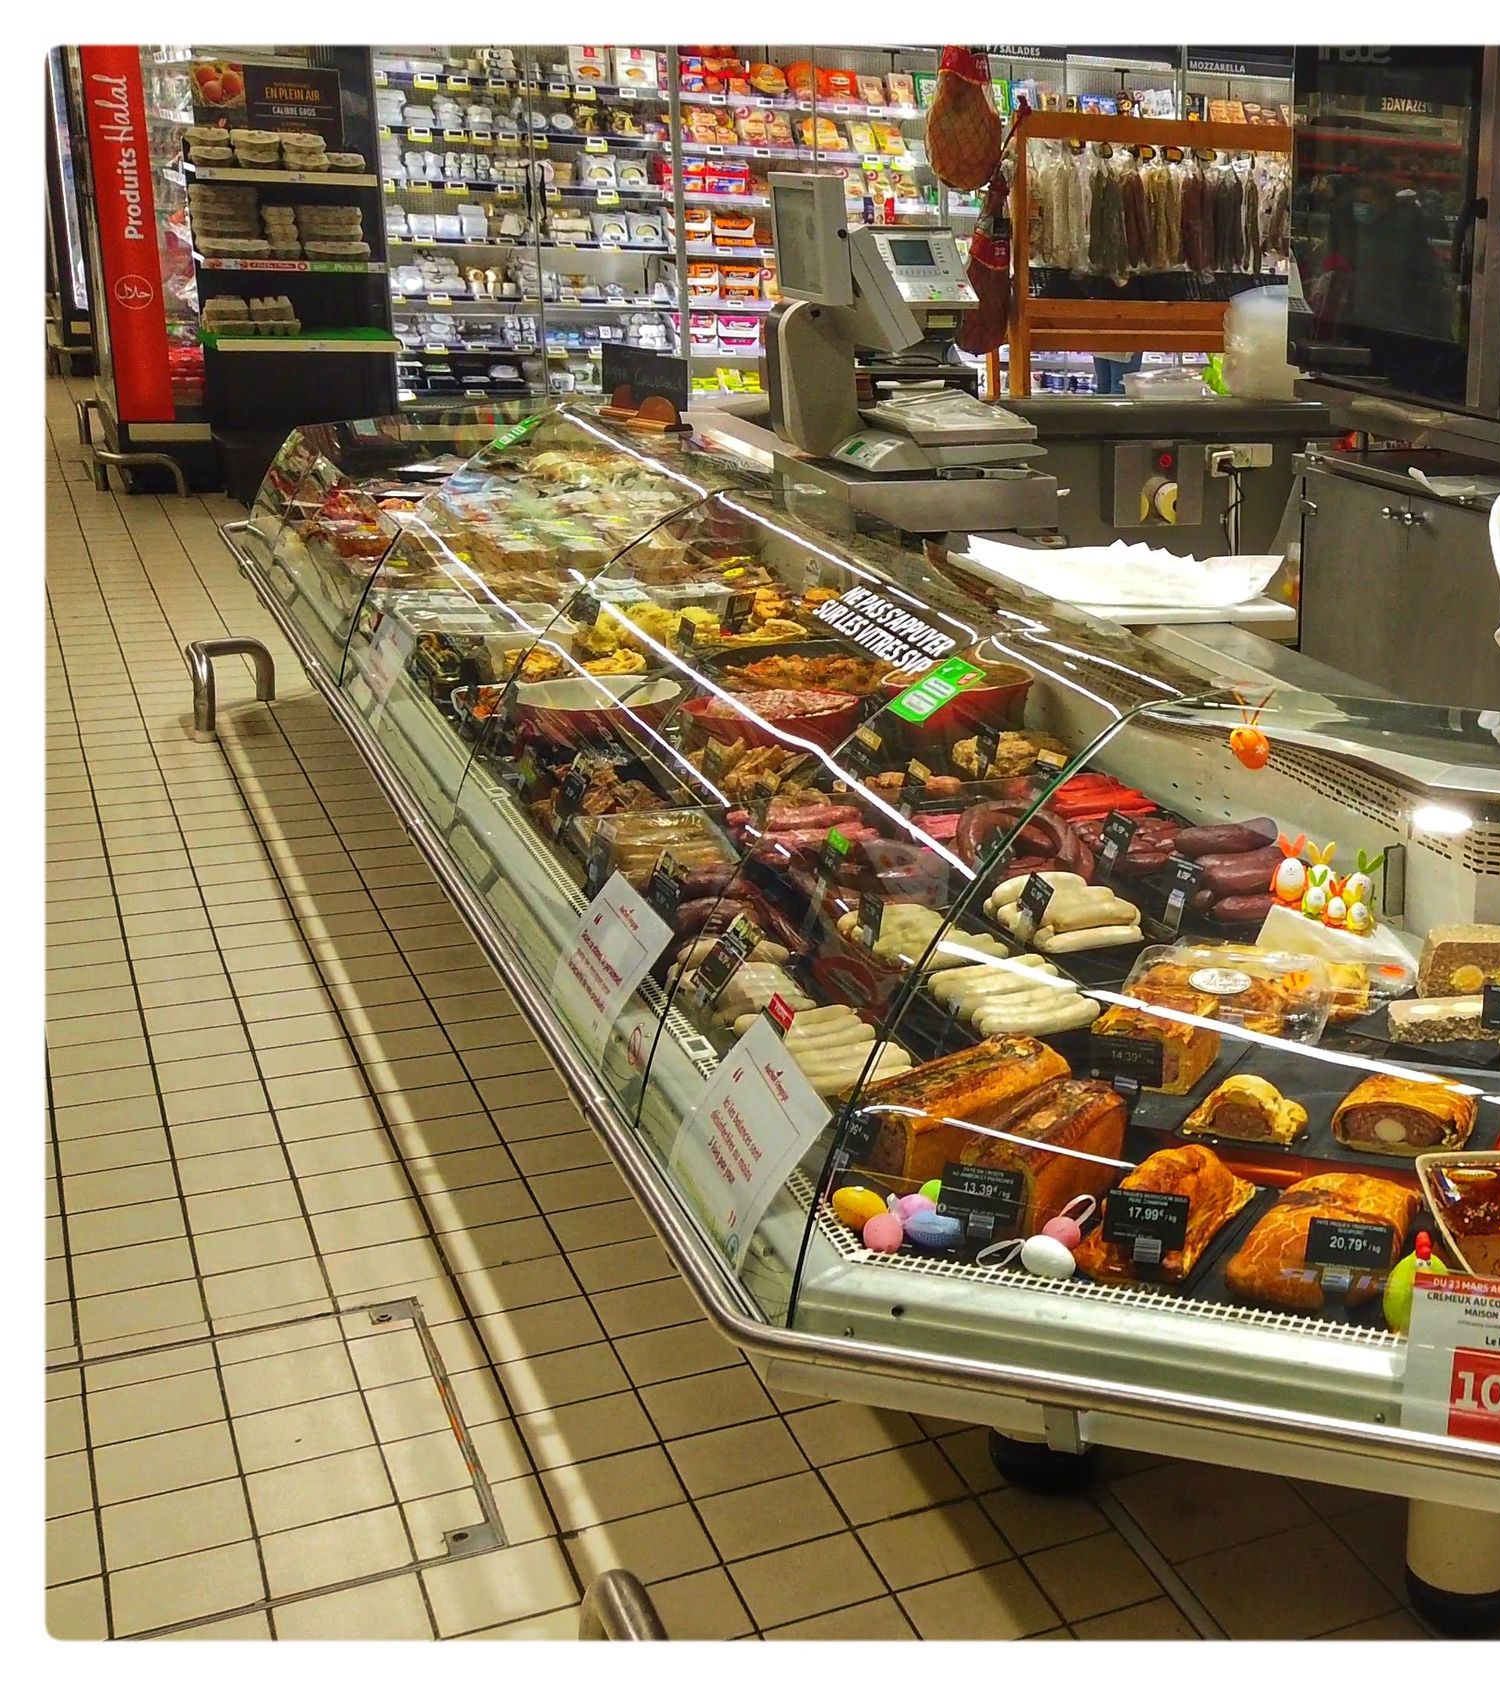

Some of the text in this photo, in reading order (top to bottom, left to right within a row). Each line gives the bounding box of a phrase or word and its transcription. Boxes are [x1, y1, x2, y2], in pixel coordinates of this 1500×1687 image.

[999, 45, 1041, 57] SALADES
[1189, 60, 1246, 74] MOZZARELLA
[264, 86, 321, 102] EN PLEIN AIR
[272, 105, 298, 116] CALIBRE
[91, 74, 145, 240] Produits Halal
[839, 585, 957, 658] NE PAS S'APPUYER
[812, 599, 934, 676] SUR LES VITRES SVP
[733, 1111, 753, 1147] balances
[748, 1143, 763, 1162] sont
[1128, 1206, 1164, 1221] 17,99€
[1329, 1235, 1367, 1251] 20,79€
[1433, 1277, 1447, 1288] DU
[1461, 1281, 1489, 1294] MARS
[1473, 1296, 1488, 1308] AU
[1464, 1307, 1499, 1320] MAISON
[1485, 1336, 1497, 1347] Le
